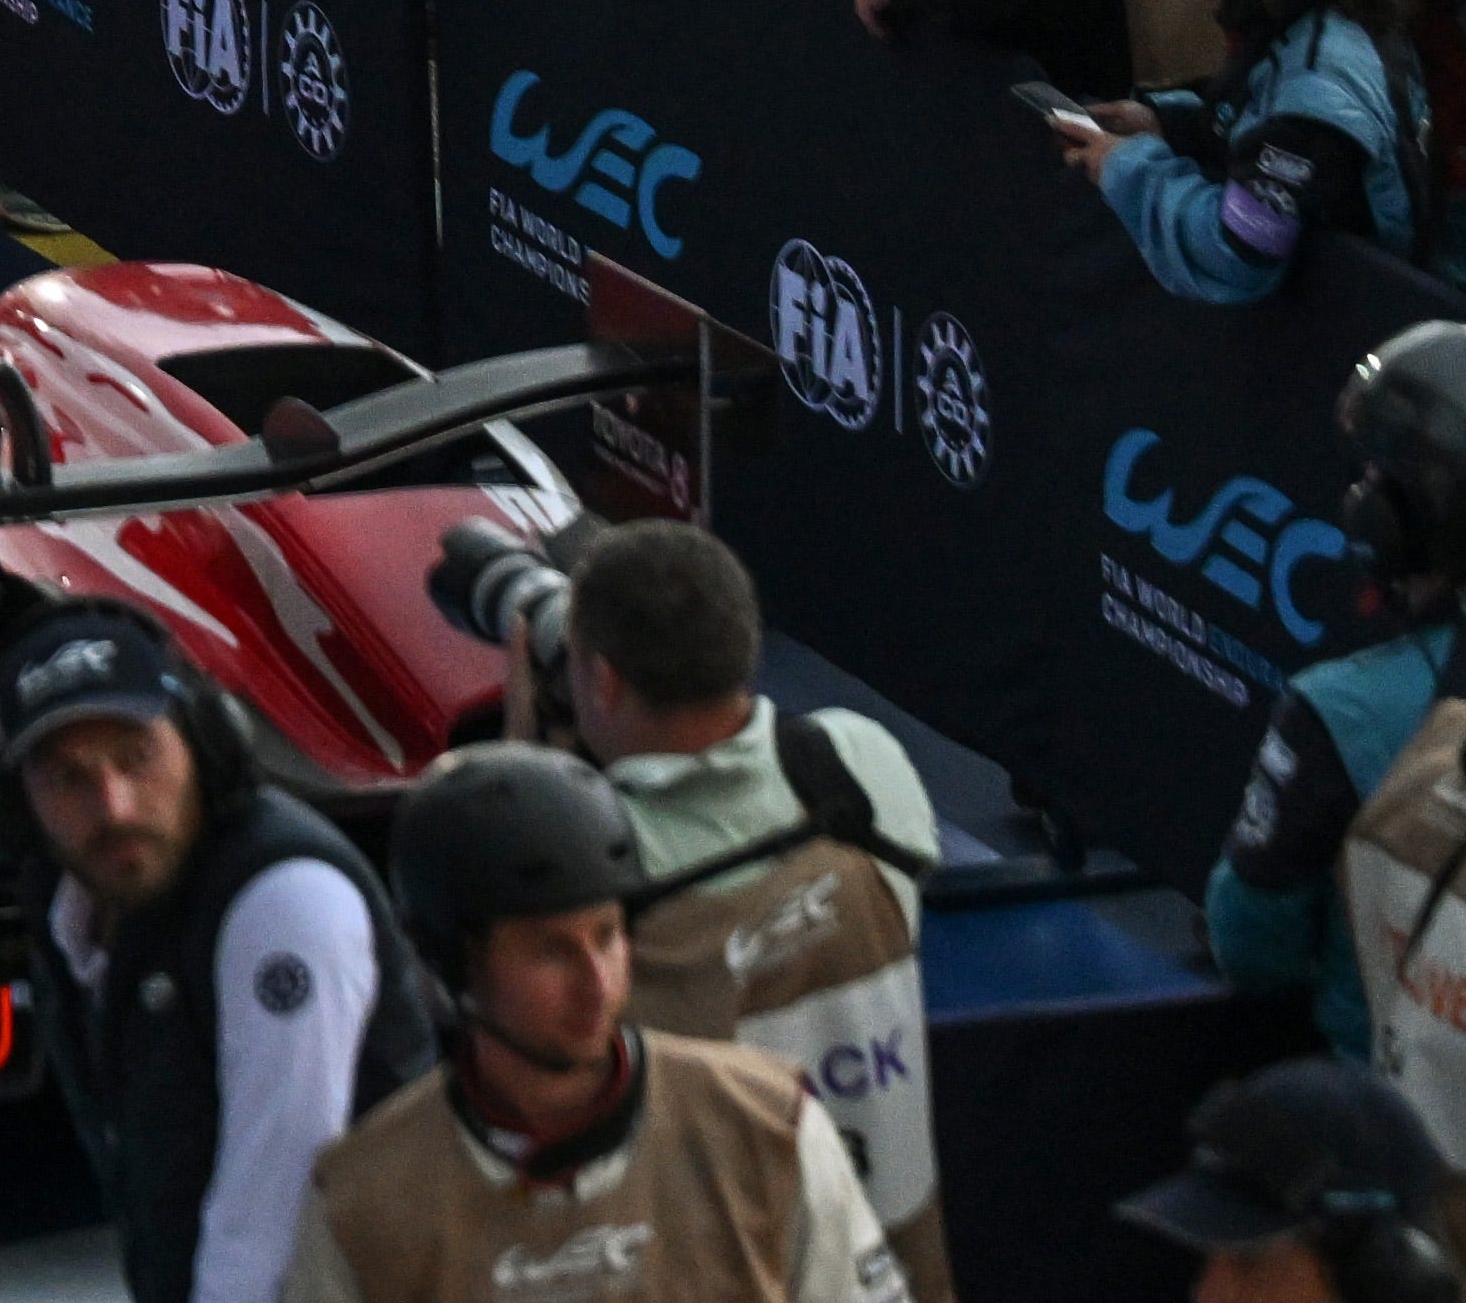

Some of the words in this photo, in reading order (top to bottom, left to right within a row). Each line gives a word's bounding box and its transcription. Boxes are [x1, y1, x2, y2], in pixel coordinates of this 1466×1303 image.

[488, 69, 703, 260] WEC
[489, 187, 518, 225] FIA
[520, 201, 582, 266] WORLD
[489, 222, 591, 305] CHAMPIONS
[1101, 427, 1349, 648] WEC
